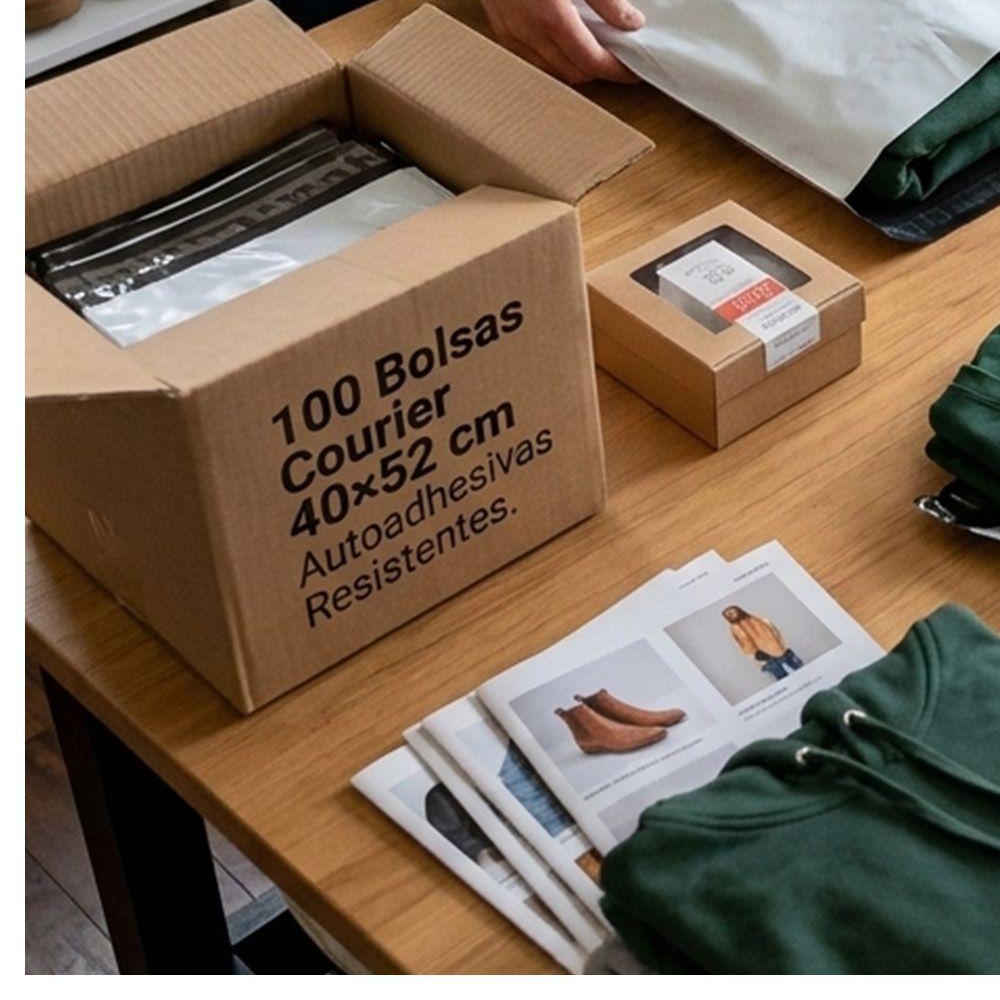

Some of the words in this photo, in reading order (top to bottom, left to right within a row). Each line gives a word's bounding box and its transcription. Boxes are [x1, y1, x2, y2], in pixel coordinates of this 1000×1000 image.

[272, 374, 361, 445] 100
[375, 300, 524, 397] Bolsas
[449, 401, 516, 455] cm
[281, 383, 451, 494] Courier
[300, 429, 553, 588] Autoadhesivas
[306, 497, 517, 627] Resistentes.
